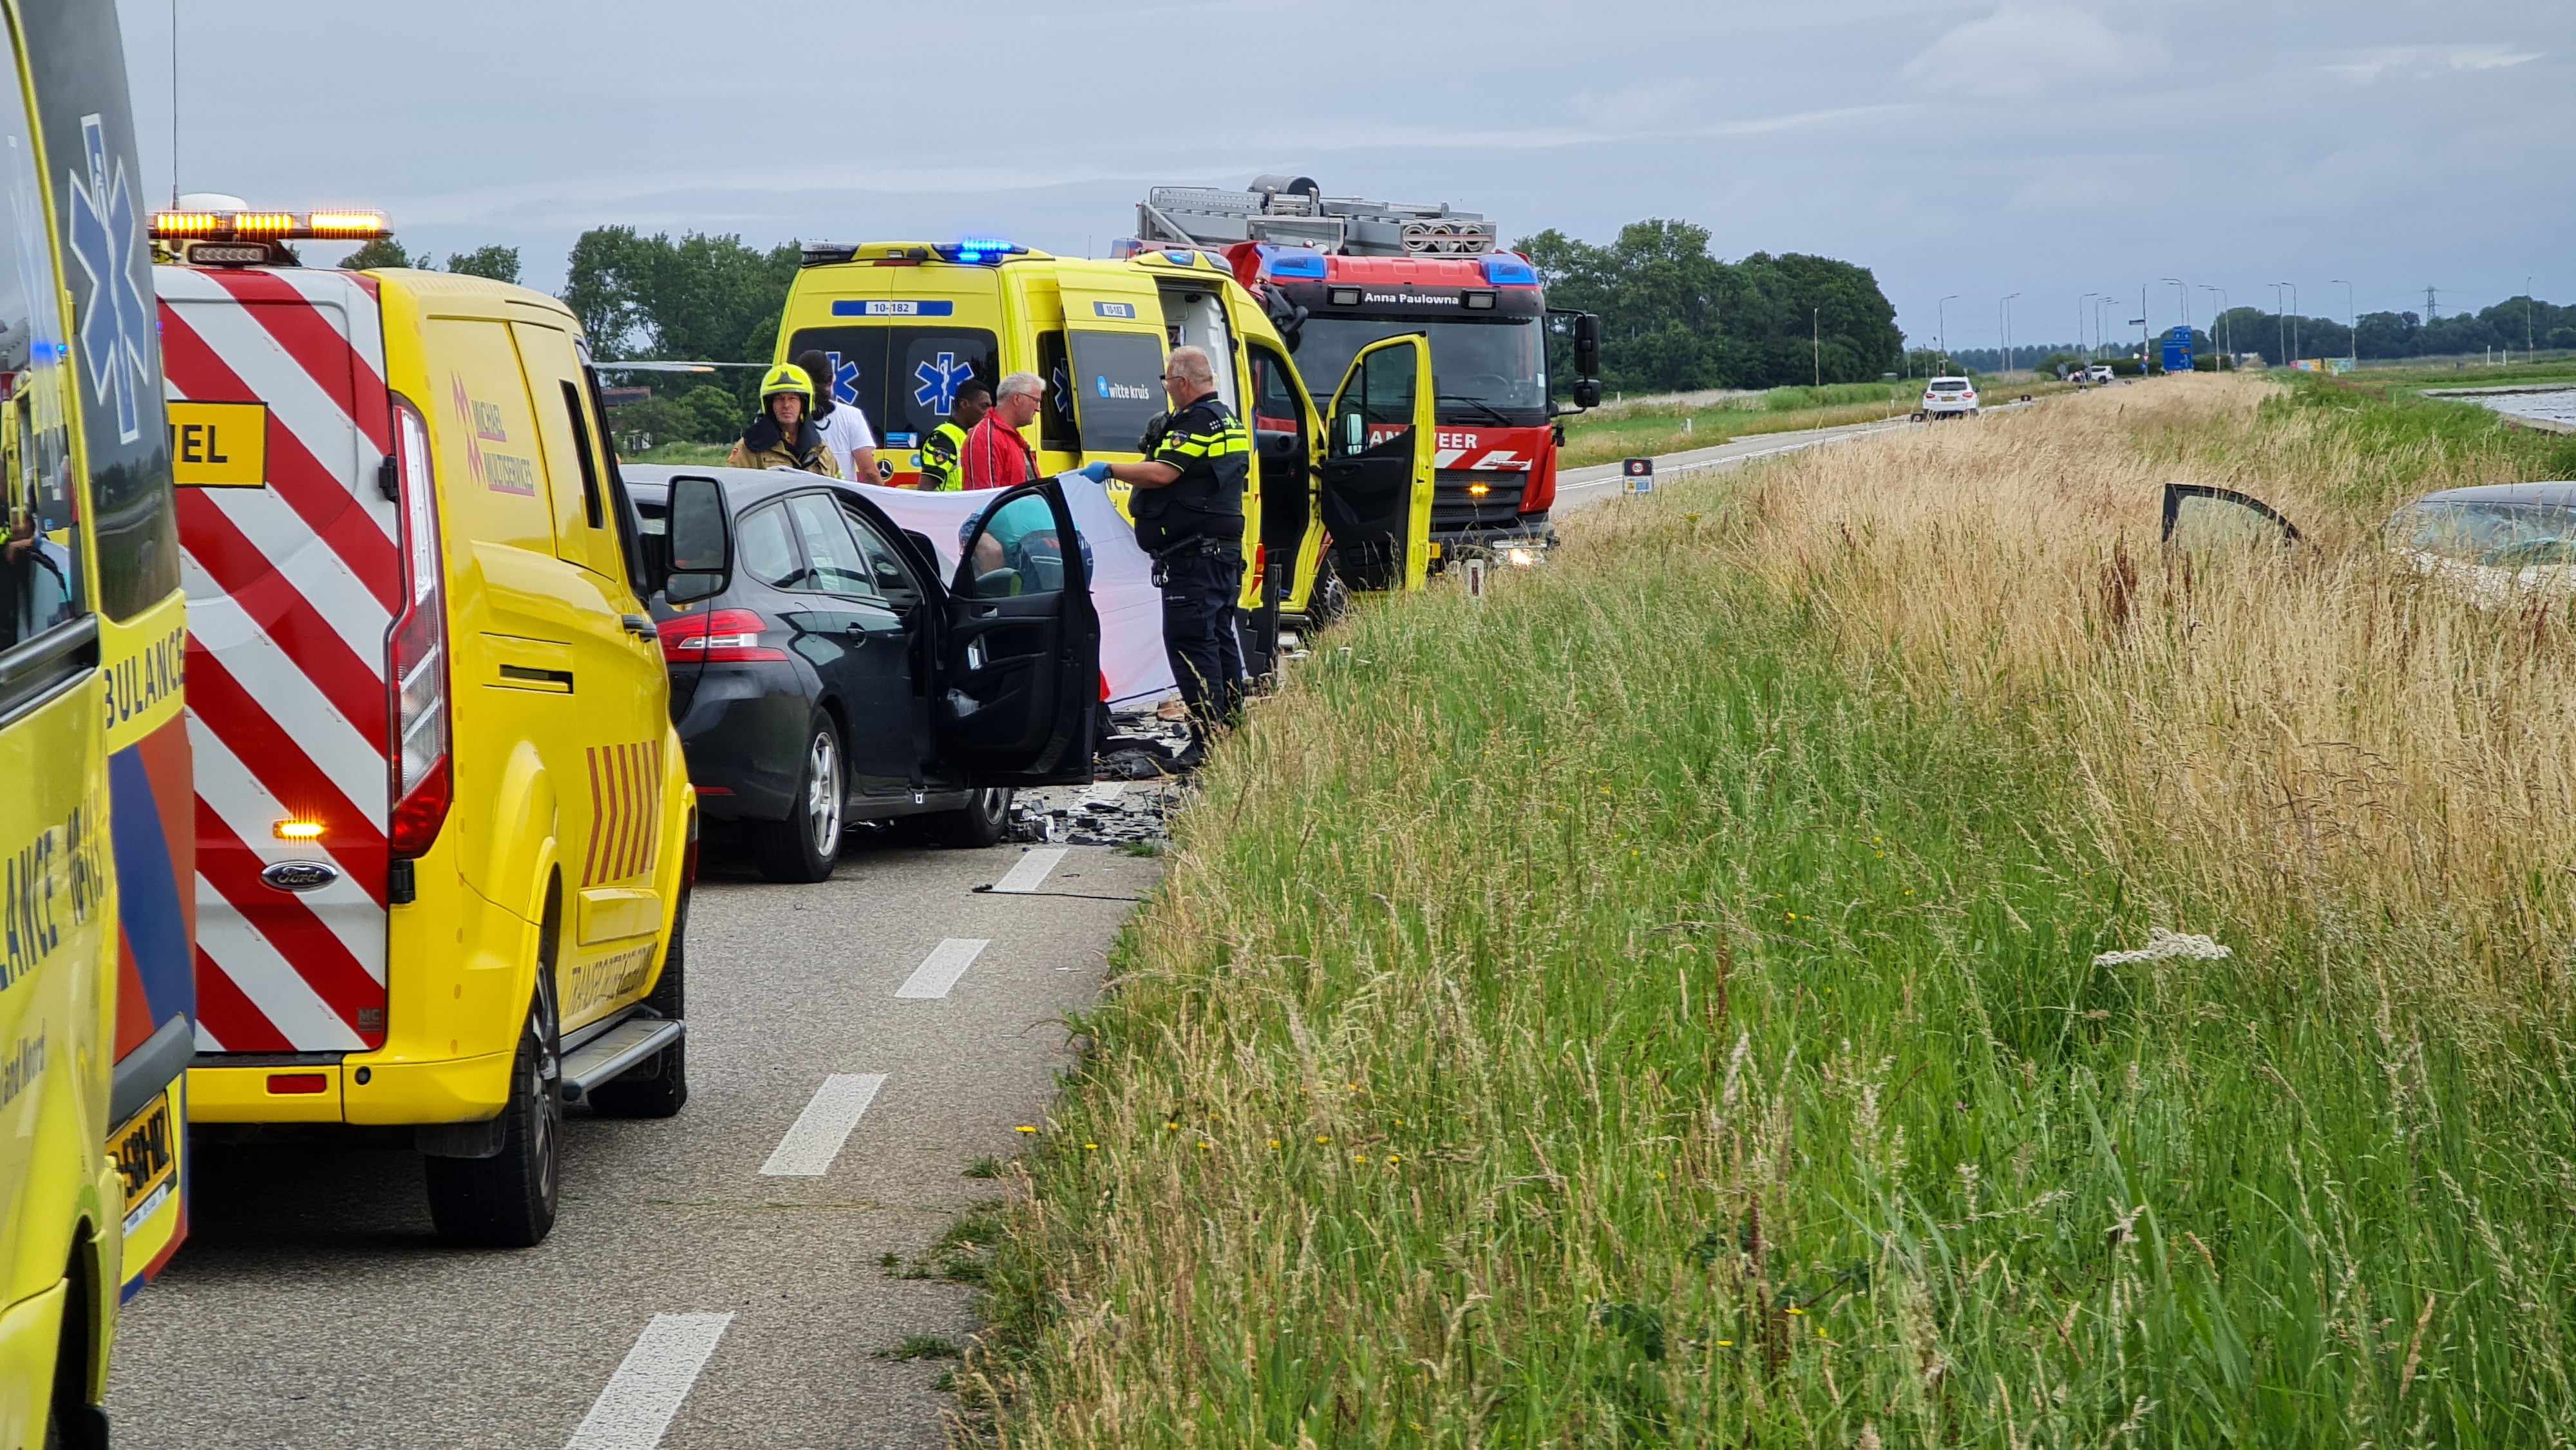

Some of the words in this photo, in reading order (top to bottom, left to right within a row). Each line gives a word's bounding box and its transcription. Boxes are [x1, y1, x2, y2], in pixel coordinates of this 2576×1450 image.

[1364, 292, 1396, 303] Anna
[1399, 294, 1459, 305] Paulowna
[873, 303, 909, 312] 10-182
[1108, 382, 1131, 399] witte
[1130, 383, 1150, 400] kruis
[277, 866, 323, 884] Ford
